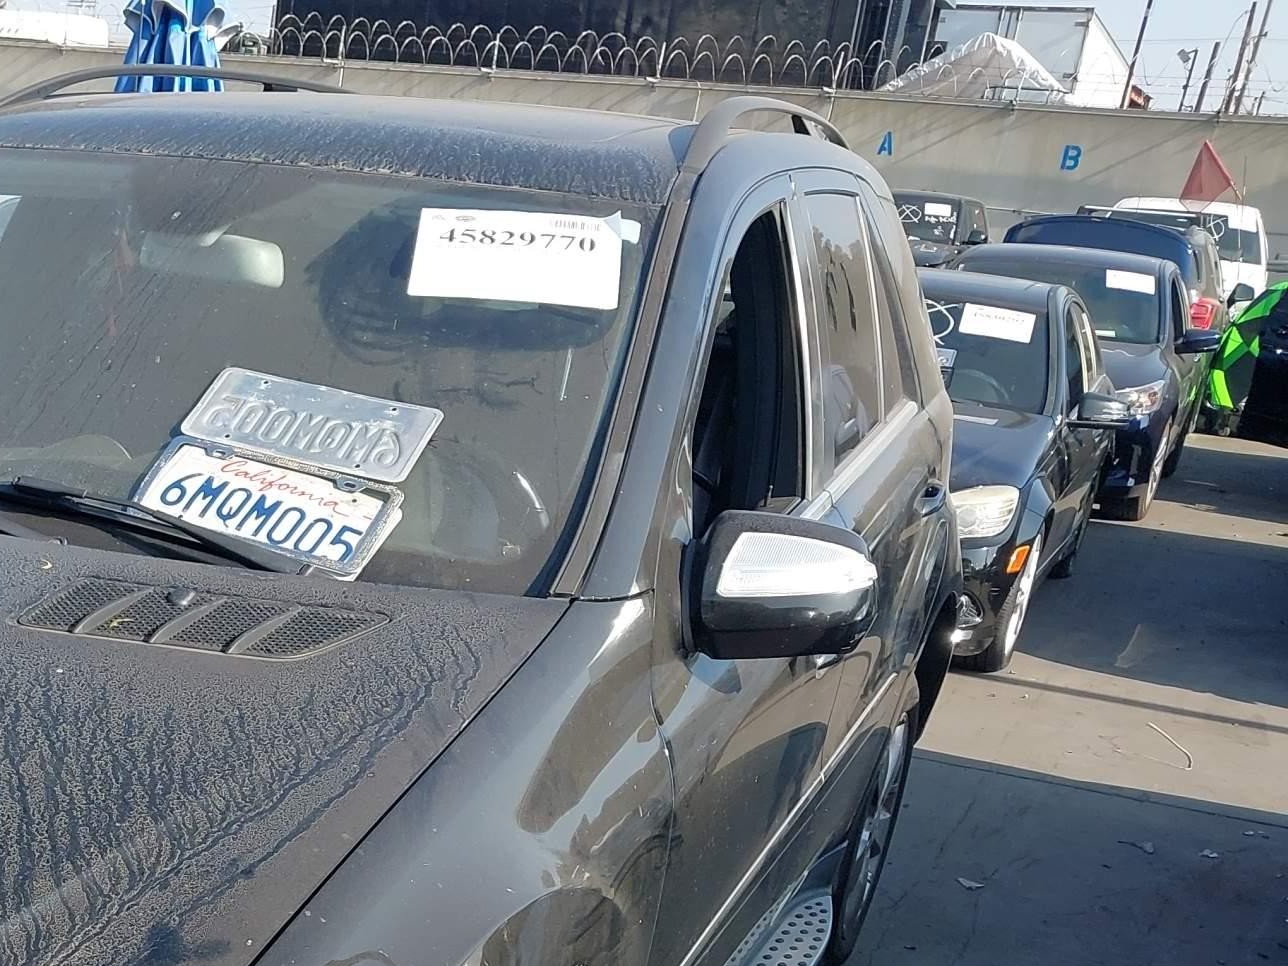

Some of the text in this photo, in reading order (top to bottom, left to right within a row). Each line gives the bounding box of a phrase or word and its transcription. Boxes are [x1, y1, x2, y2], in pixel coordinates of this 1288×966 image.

[877, 131, 893, 156] A
[1060, 144, 1082, 171] B
[439, 227, 596, 252] 45829770
[220, 458, 353, 517] California
[159, 472, 364, 565] 6MQM005
